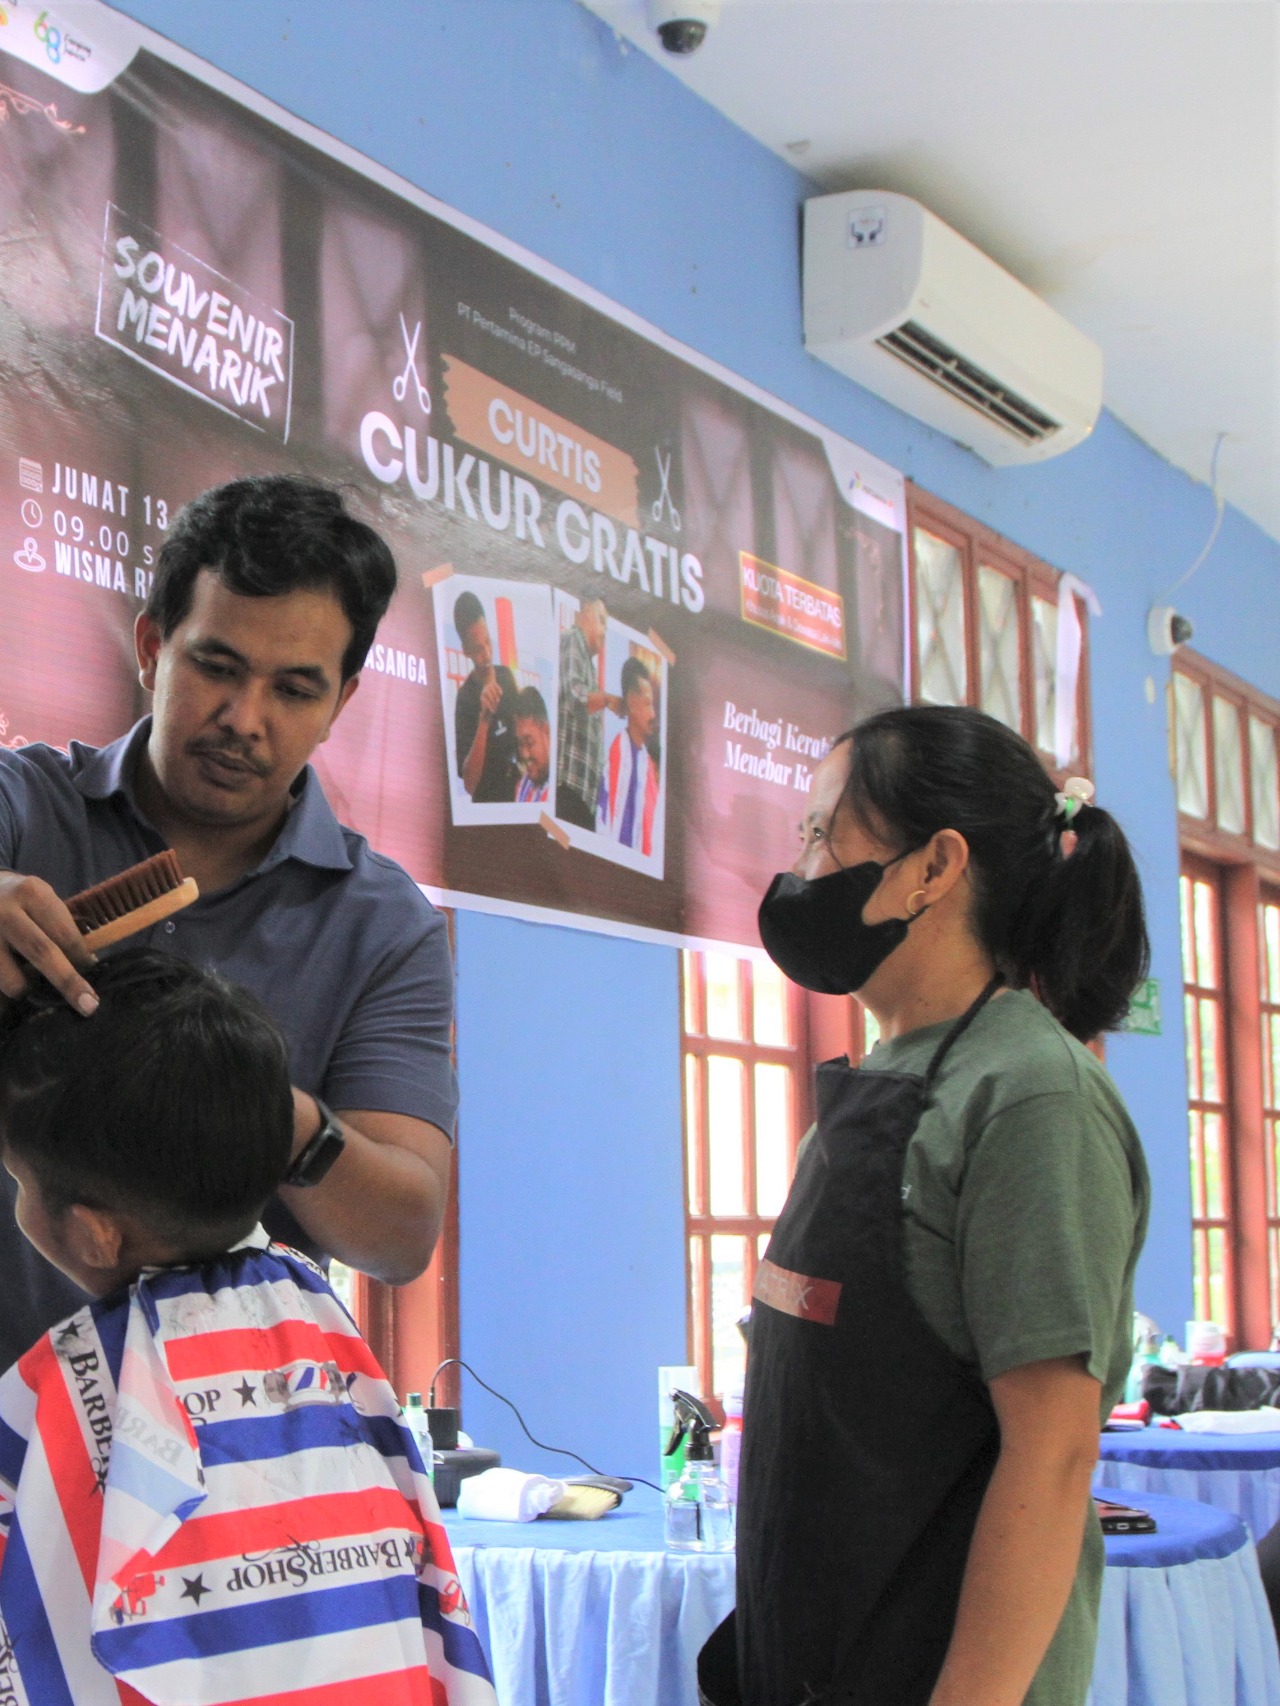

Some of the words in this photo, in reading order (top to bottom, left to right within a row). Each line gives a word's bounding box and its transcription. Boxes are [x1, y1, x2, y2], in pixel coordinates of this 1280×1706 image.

[114, 236, 285, 382] SOUVENIR
[457, 301, 470, 320] PT
[472, 310, 526, 350] Pertamina
[527, 340, 541, 356] EP
[509, 307, 552, 342] Program
[117, 287, 276, 418] MENARIK
[488, 398, 602, 494] CURTIS
[52, 463, 129, 517] JUMAT
[143, 495, 168, 530] 13
[360, 411, 545, 549] CUKUR
[556, 499, 705, 614] GRATIS
[54, 510, 129, 556] 09.00
[55, 541, 126, 593] WISMA
[364, 644, 428, 686] ASANGA
[743, 567, 784, 603] KUOTA
[784, 584, 841, 628] TERBATAS
[723, 701, 782, 749] Berbagi
[724, 740, 792, 786] Menebar
[70, 1349, 113, 1464] BARBE
